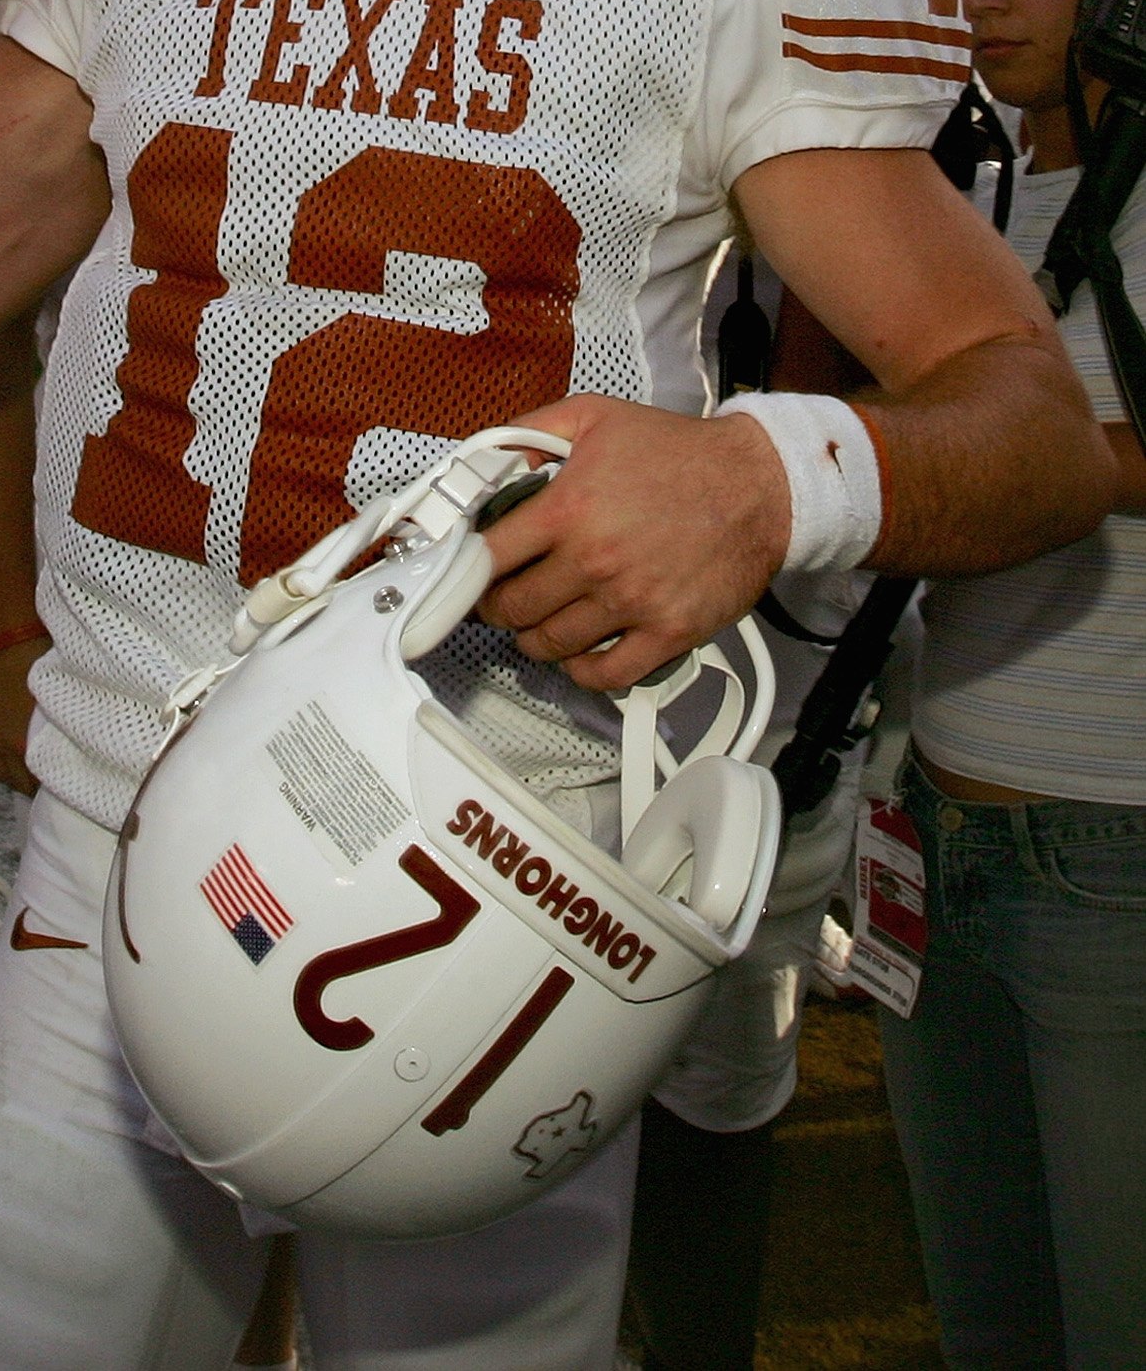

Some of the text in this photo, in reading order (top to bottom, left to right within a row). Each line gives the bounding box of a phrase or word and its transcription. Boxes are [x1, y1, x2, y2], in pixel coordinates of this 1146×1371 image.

[71, 122, 582, 589] 12
[278, 781, 317, 832] WARNING
[446, 799, 657, 984] LONGHORNS
[293, 843, 575, 1137] 12
